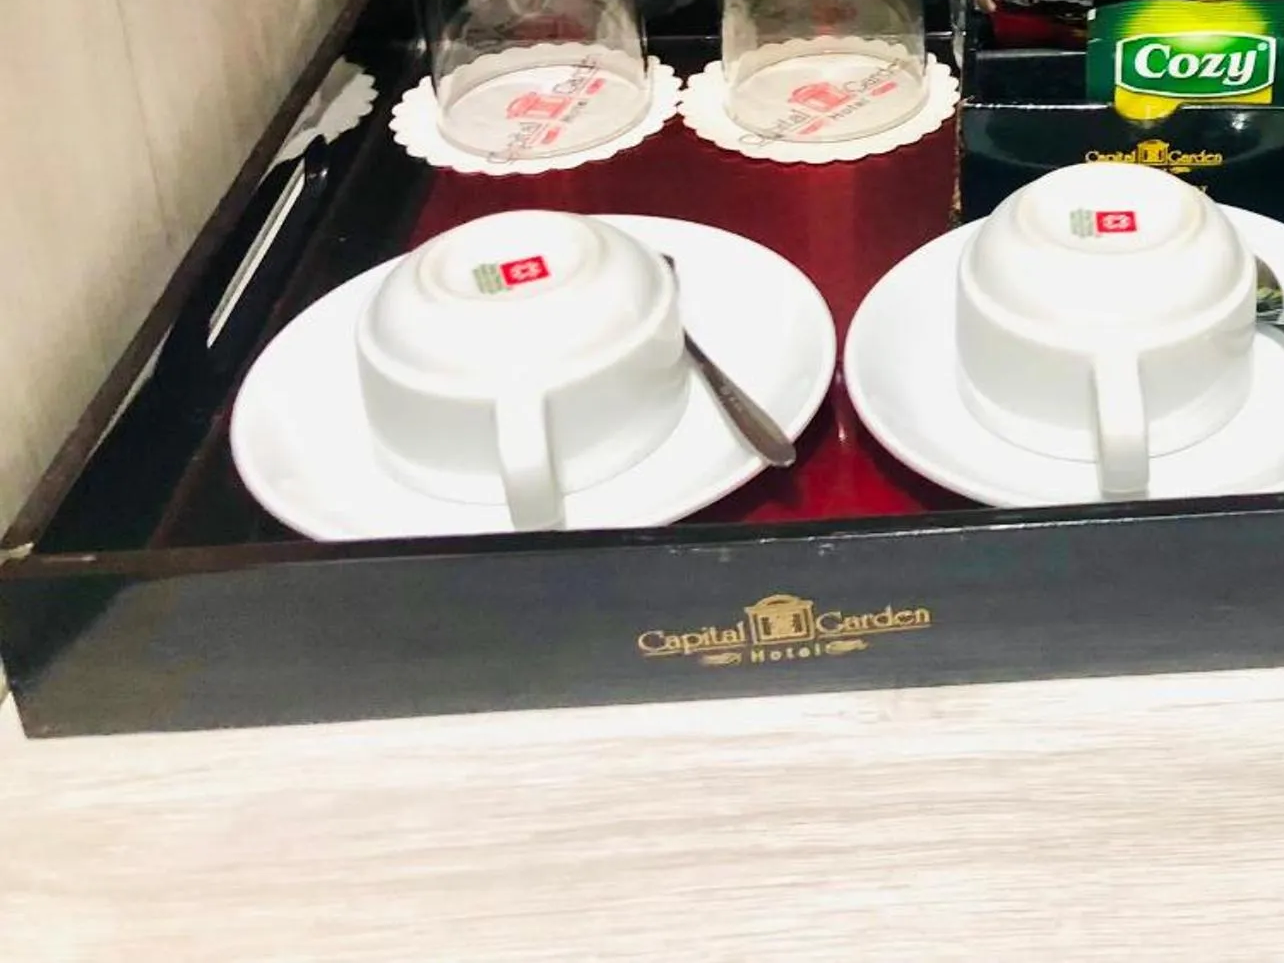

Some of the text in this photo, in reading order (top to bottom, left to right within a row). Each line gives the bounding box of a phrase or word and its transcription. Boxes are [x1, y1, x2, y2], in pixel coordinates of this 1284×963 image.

[1134, 43, 1257, 86] Cozy
[637, 605, 931, 655] Capital Garden
[751, 641, 820, 663] Hotel
